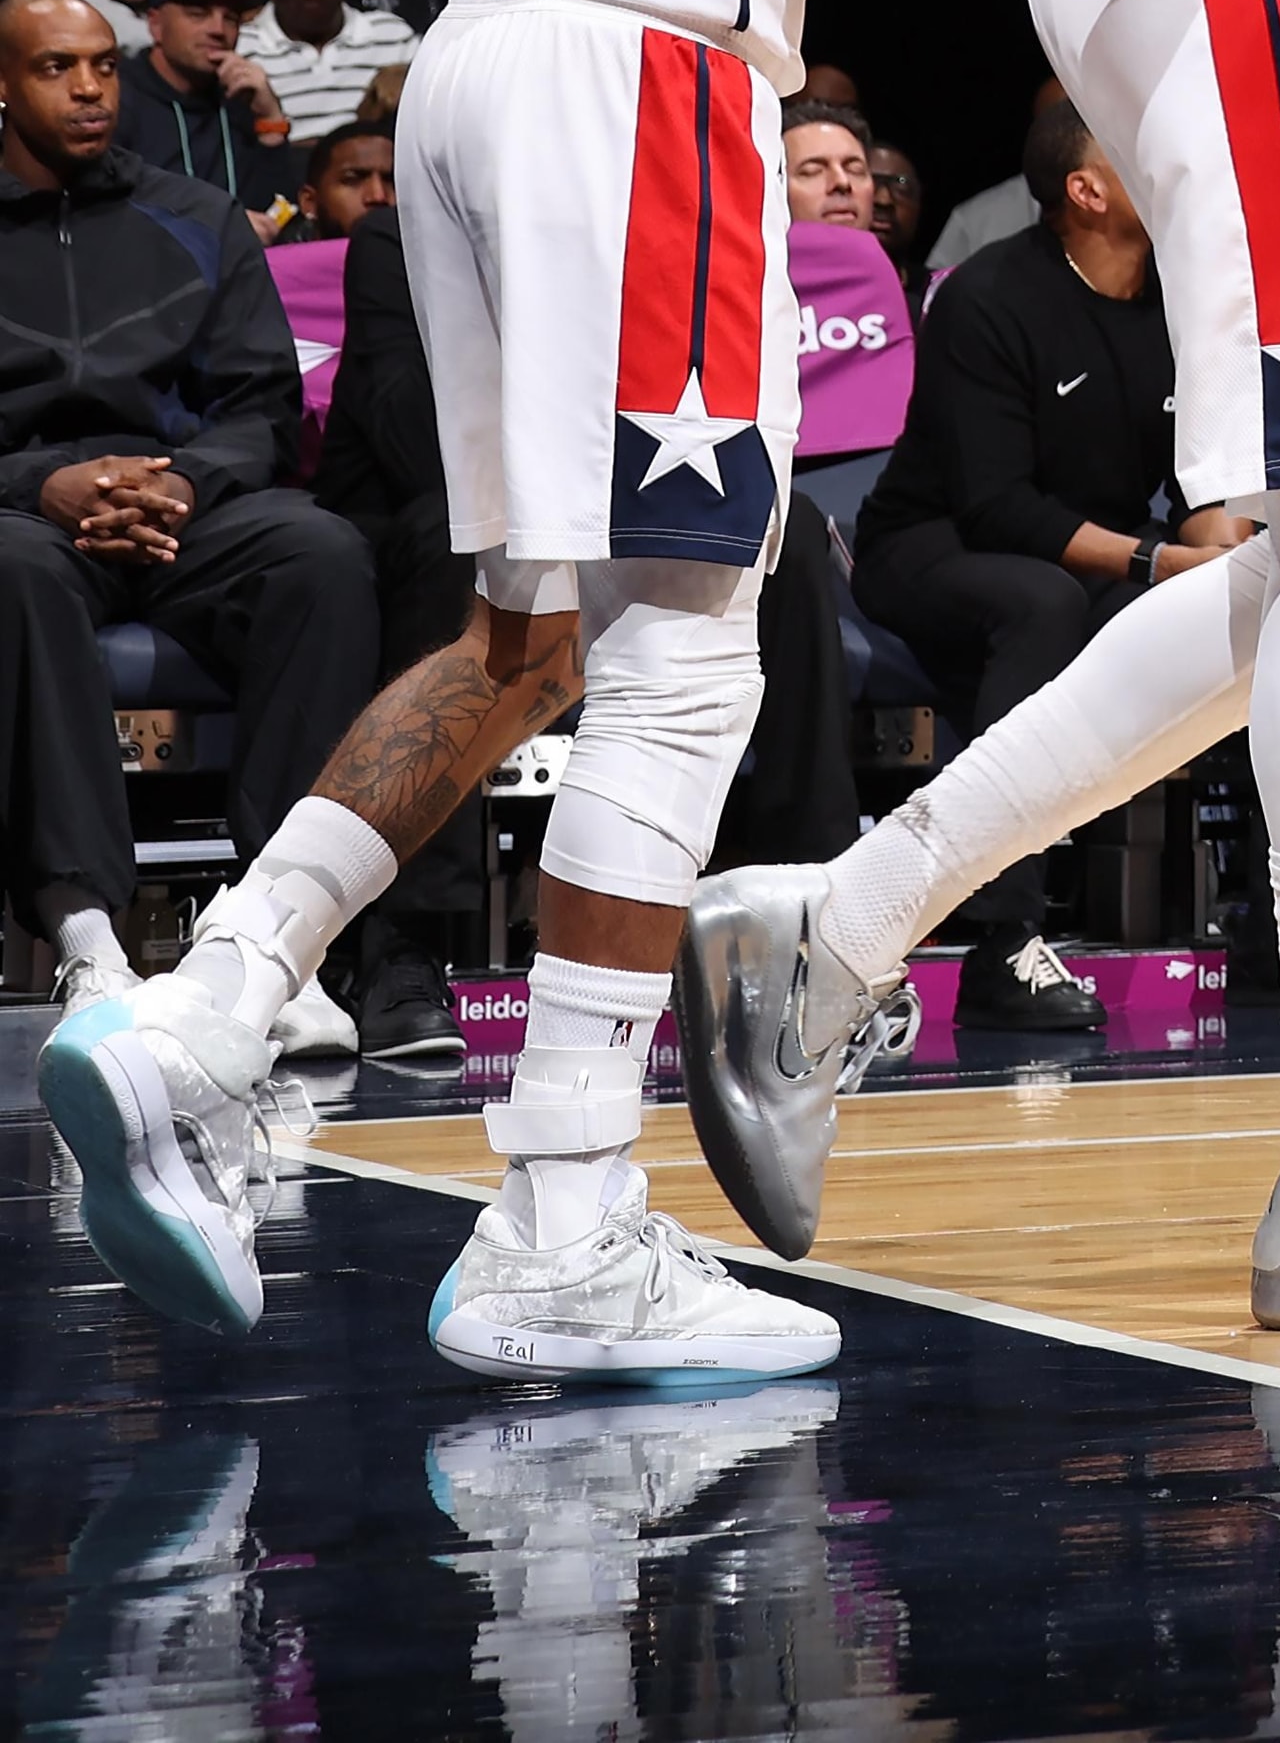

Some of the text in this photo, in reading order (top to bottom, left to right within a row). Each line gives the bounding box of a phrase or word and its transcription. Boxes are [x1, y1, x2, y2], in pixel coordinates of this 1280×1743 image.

[797, 305, 888, 355] dos
[1198, 964, 1227, 990] lei
[460, 993, 528, 1022] leido
[492, 1335, 535, 1362] Teal
